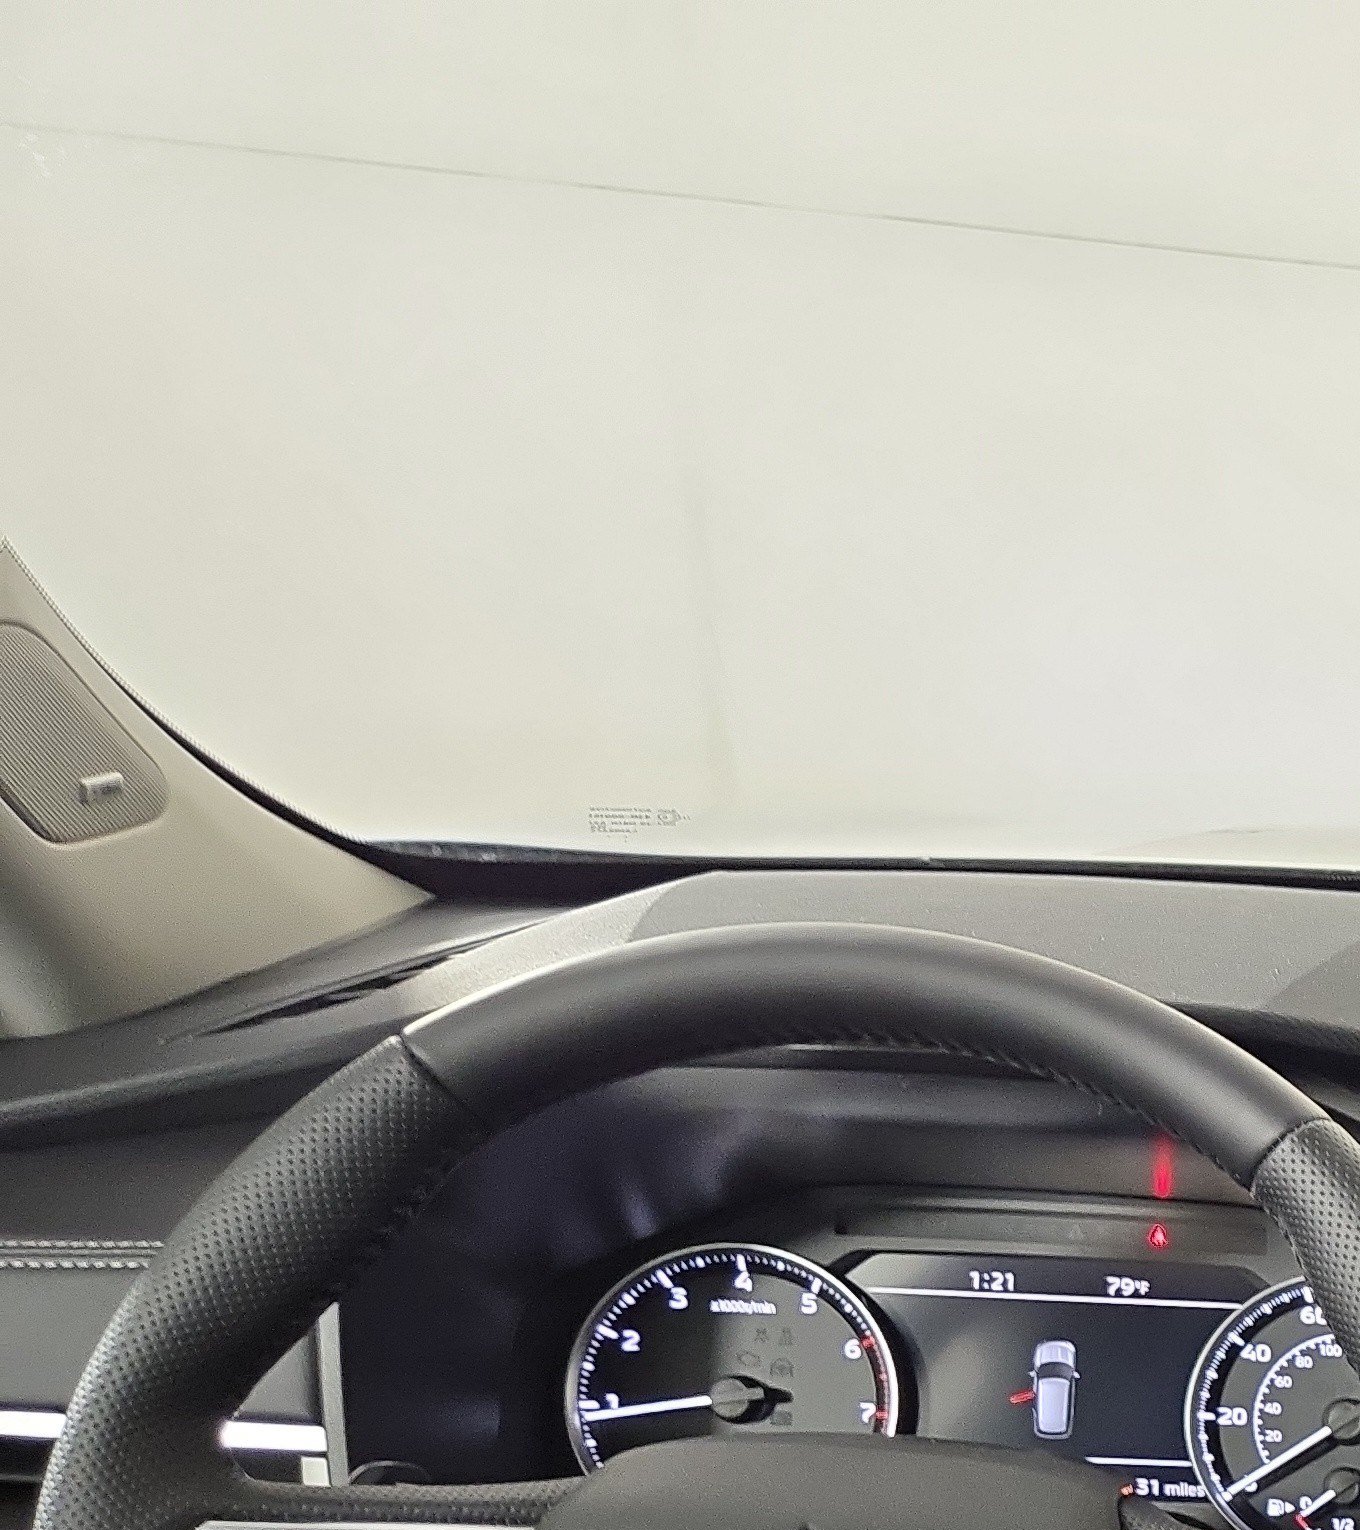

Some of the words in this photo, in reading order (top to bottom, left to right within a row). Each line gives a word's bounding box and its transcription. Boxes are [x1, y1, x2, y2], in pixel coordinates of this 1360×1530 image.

[733, 1270, 754, 1293] 4
[968, 1270, 1016, 1292] 1:21
[668, 1286, 689, 1311] 3
[800, 1292, 818, 1316] 5
[620, 1328, 641, 1352] 2
[843, 1338, 862, 1360] 6
[1319, 1344, 1343, 1358] 100
[1240, 1344, 1272, 1363] 40
[858, 1401, 877, 1424] 7
[1216, 1406, 1249, 1426] 20
[1264, 1430, 1283, 1443] 20
[1134, 1477, 1161, 1497] 31
[1163, 1480, 1206, 1498] miles
